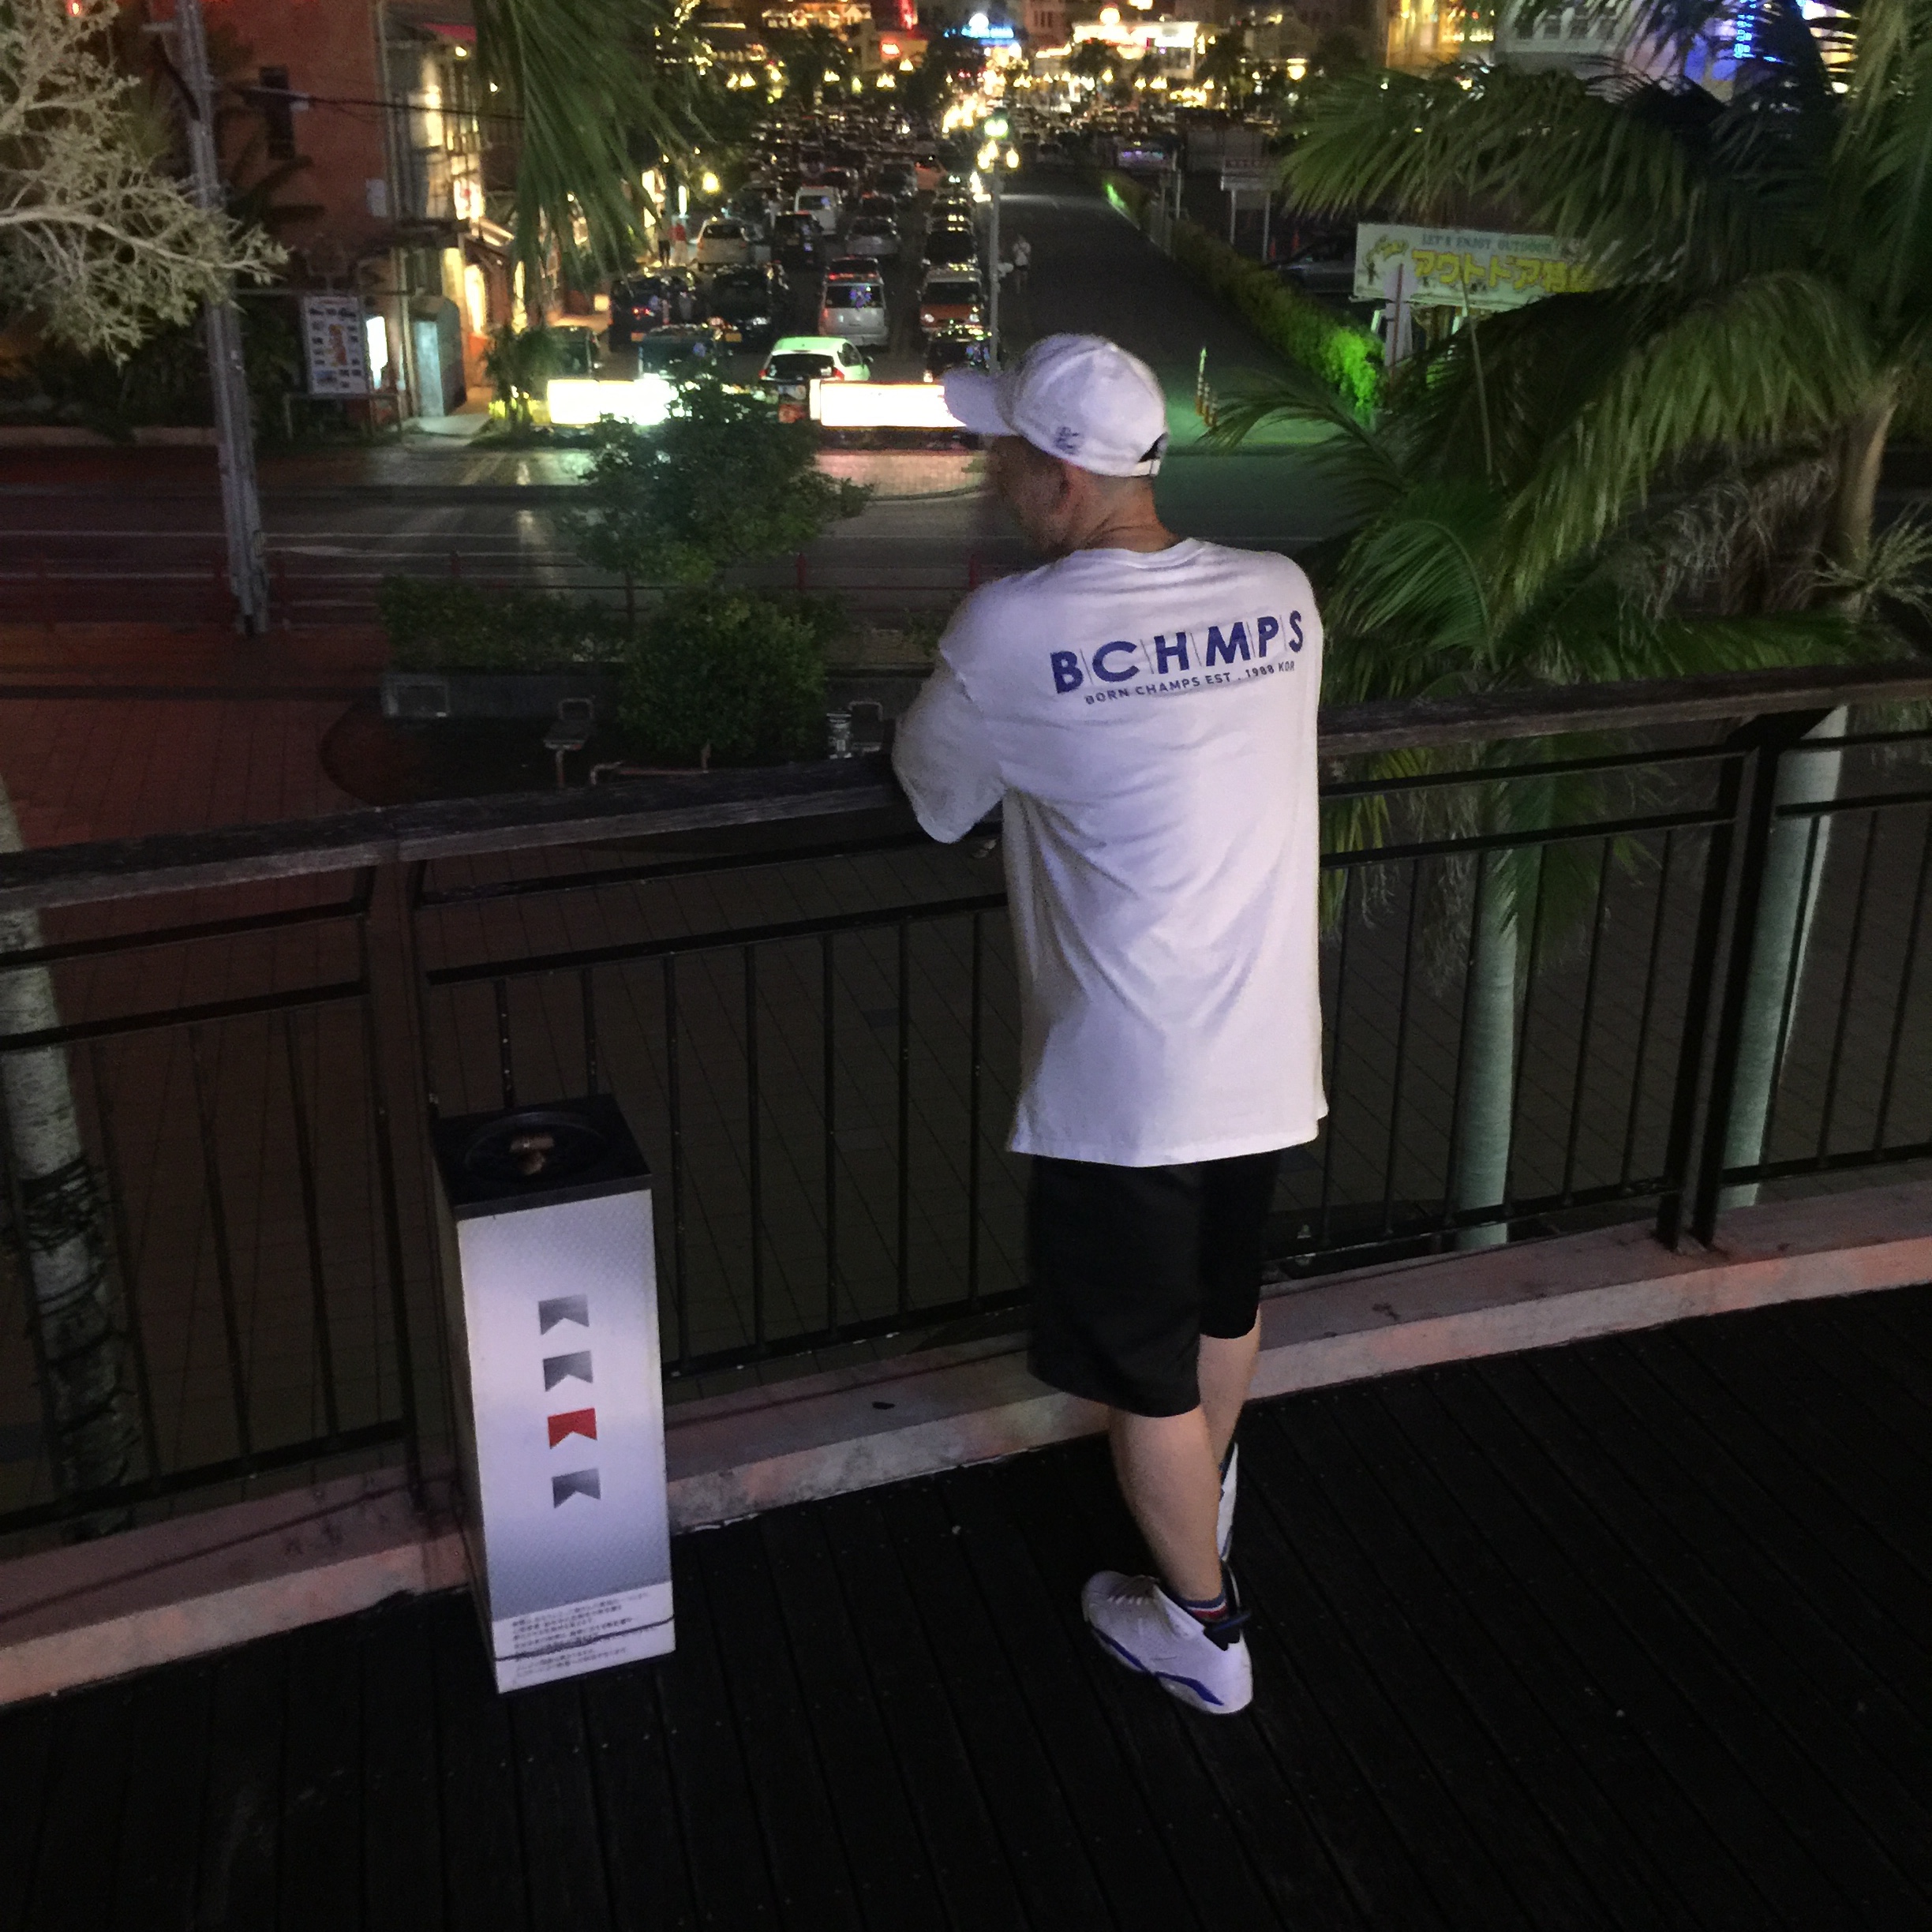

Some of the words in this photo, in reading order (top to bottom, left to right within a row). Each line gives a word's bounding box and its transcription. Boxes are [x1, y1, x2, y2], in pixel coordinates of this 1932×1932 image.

[1084, 687, 1130, 705] BORN
[1135, 676, 1201, 696] CHAMPS
[1245, 665, 1275, 679] 1988
